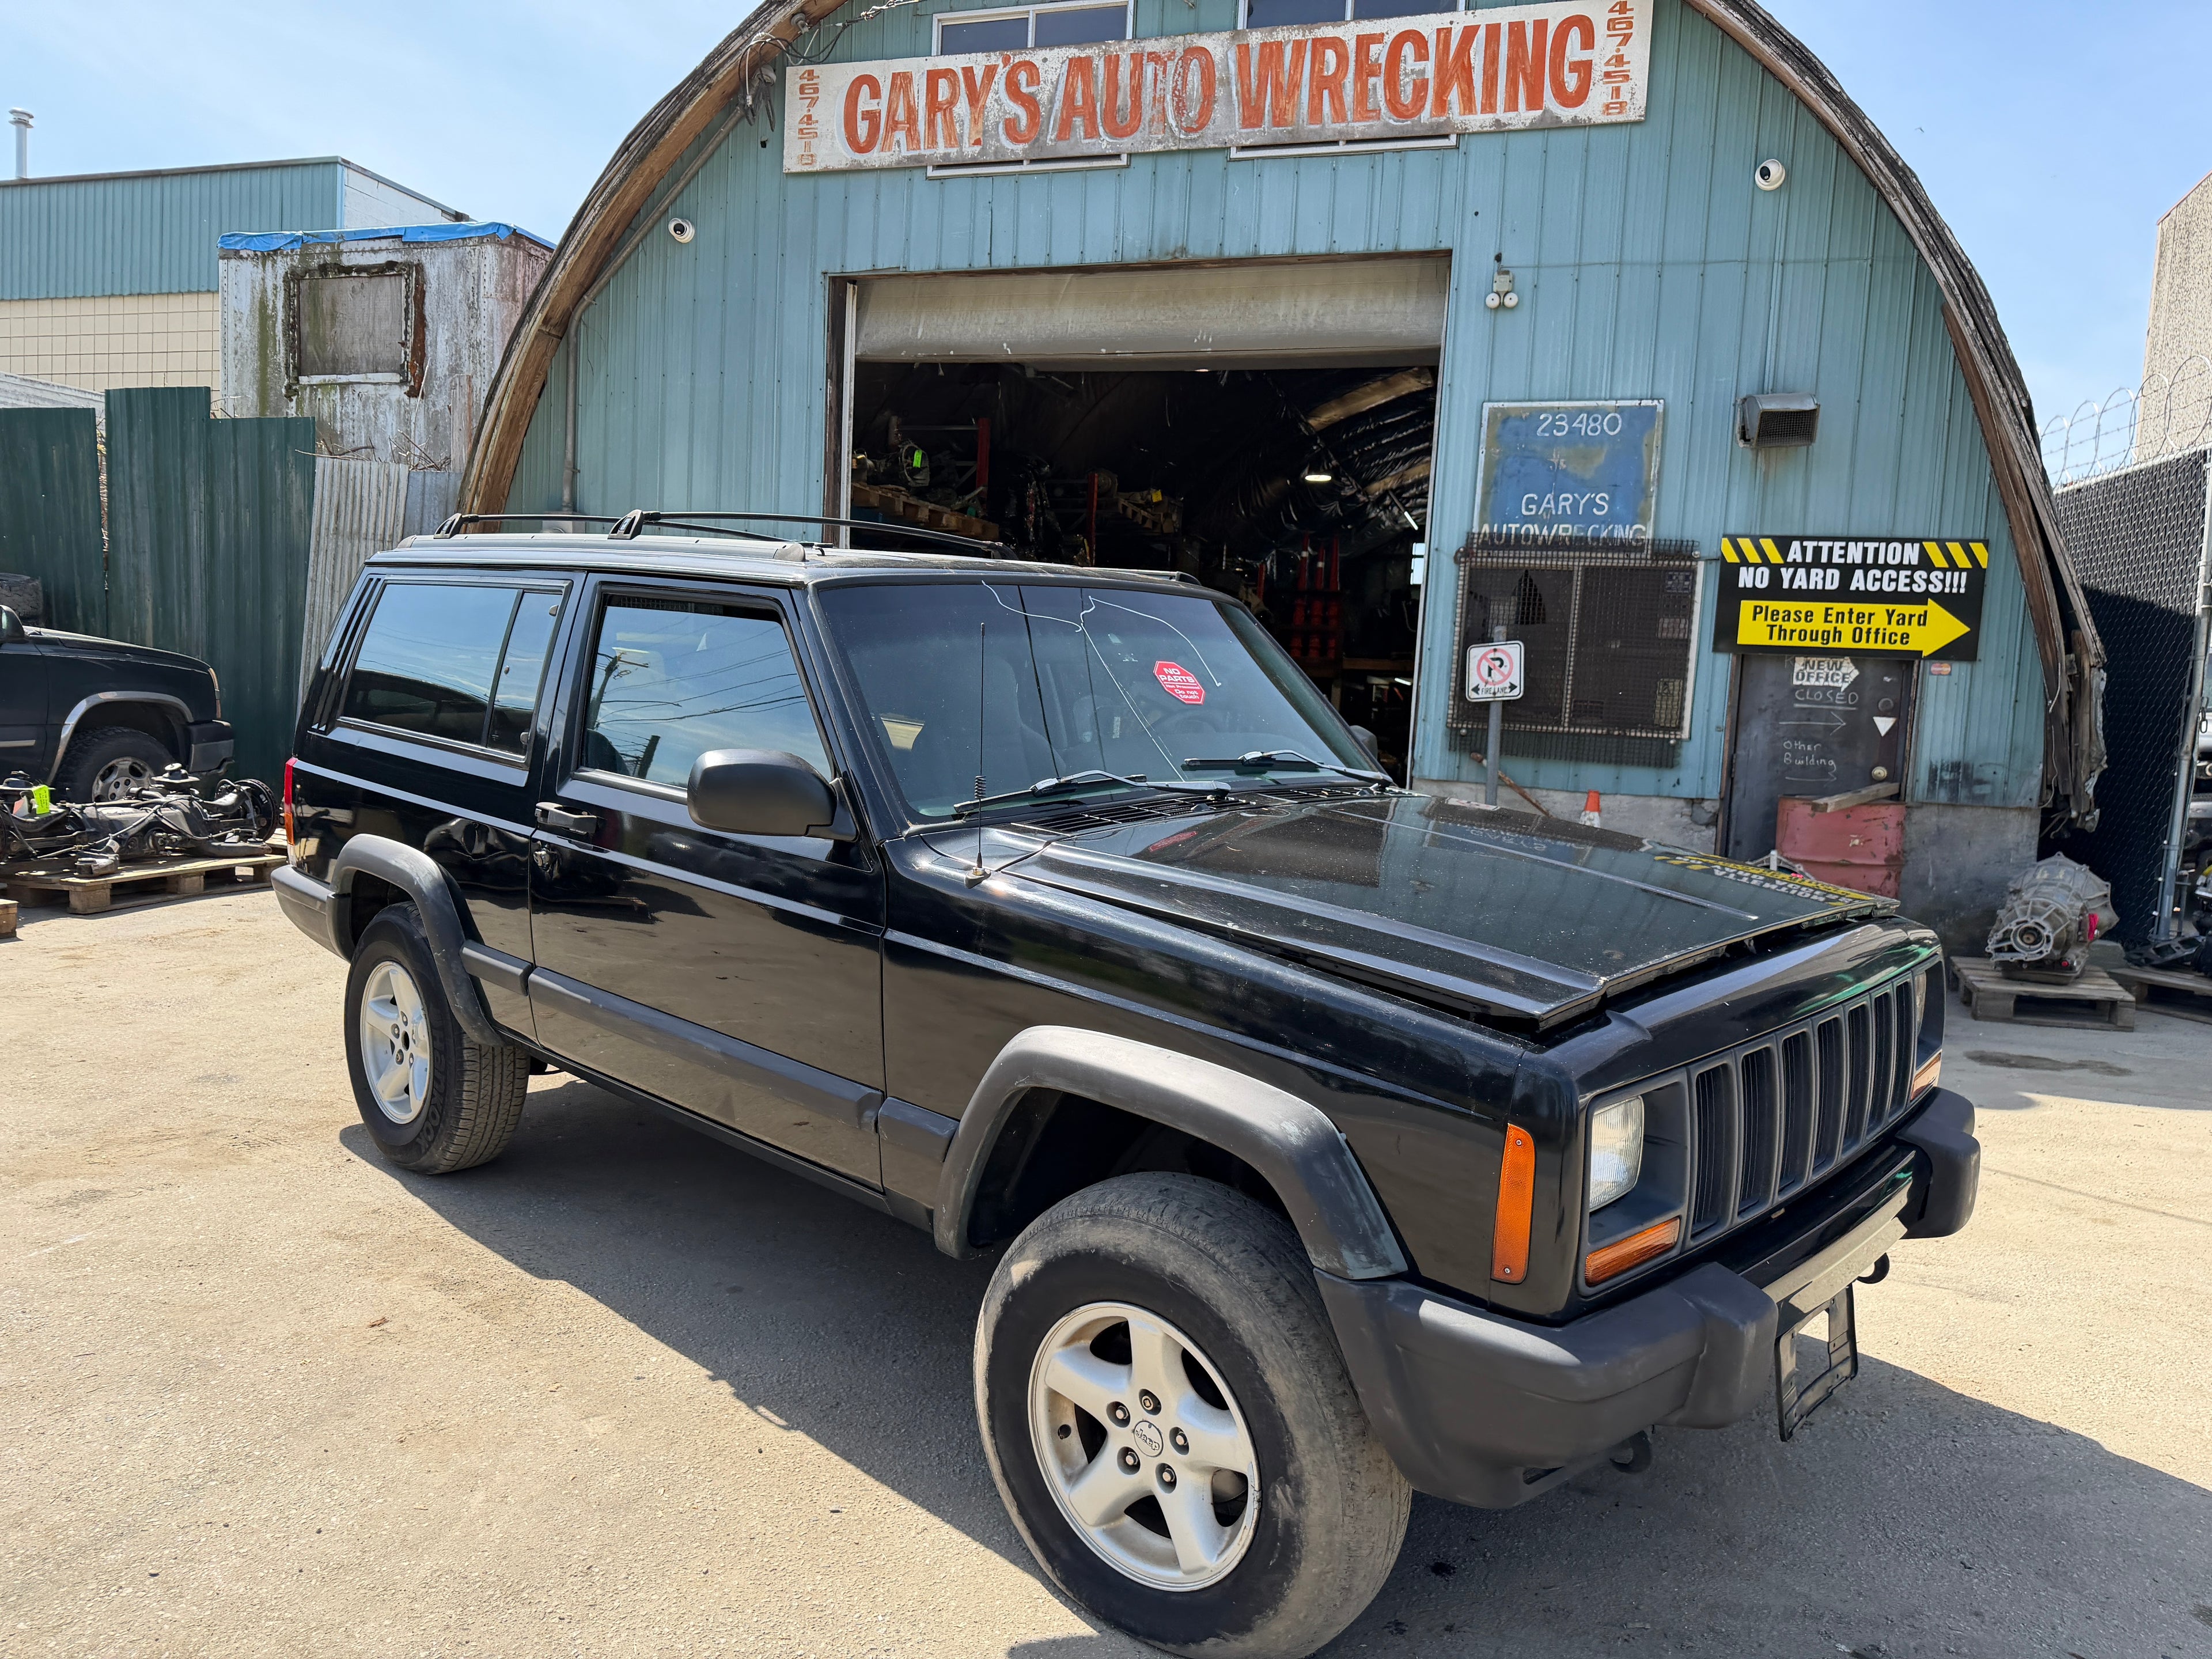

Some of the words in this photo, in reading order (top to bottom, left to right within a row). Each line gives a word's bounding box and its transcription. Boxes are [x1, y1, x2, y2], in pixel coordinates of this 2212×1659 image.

[843, 54, 1040, 154] GARY'S
[1056, 46, 1216, 141] AUTO
[1236, 14, 1595, 129] WRECKING
[1537, 413, 1622, 437] 23480
[1521, 493, 1609, 516] GARY'S
[1787, 541, 1920, 565] ATTENTION
[1738, 566, 1770, 588] NO
[1781, 567, 1840, 590] YARD
[1850, 569, 1967, 594] ACCESS!!!
[1752, 605, 1814, 623] Please
[1824, 607, 1875, 625] Enter
[1885, 609, 1928, 627] Yard
[1767, 624, 1843, 645] Through
[1851, 627, 1910, 645] Office
[1796, 669, 1851, 683] OFFICE
[1804, 660, 1843, 671] NEW
[1159, 675, 1195, 683] PARTS
[1795, 689, 1858, 704] CLOSED
[1783, 741, 1821, 751] Other
[1783, 752, 1836, 771] Building
[1135, 1429, 1160, 1450] Jeep
